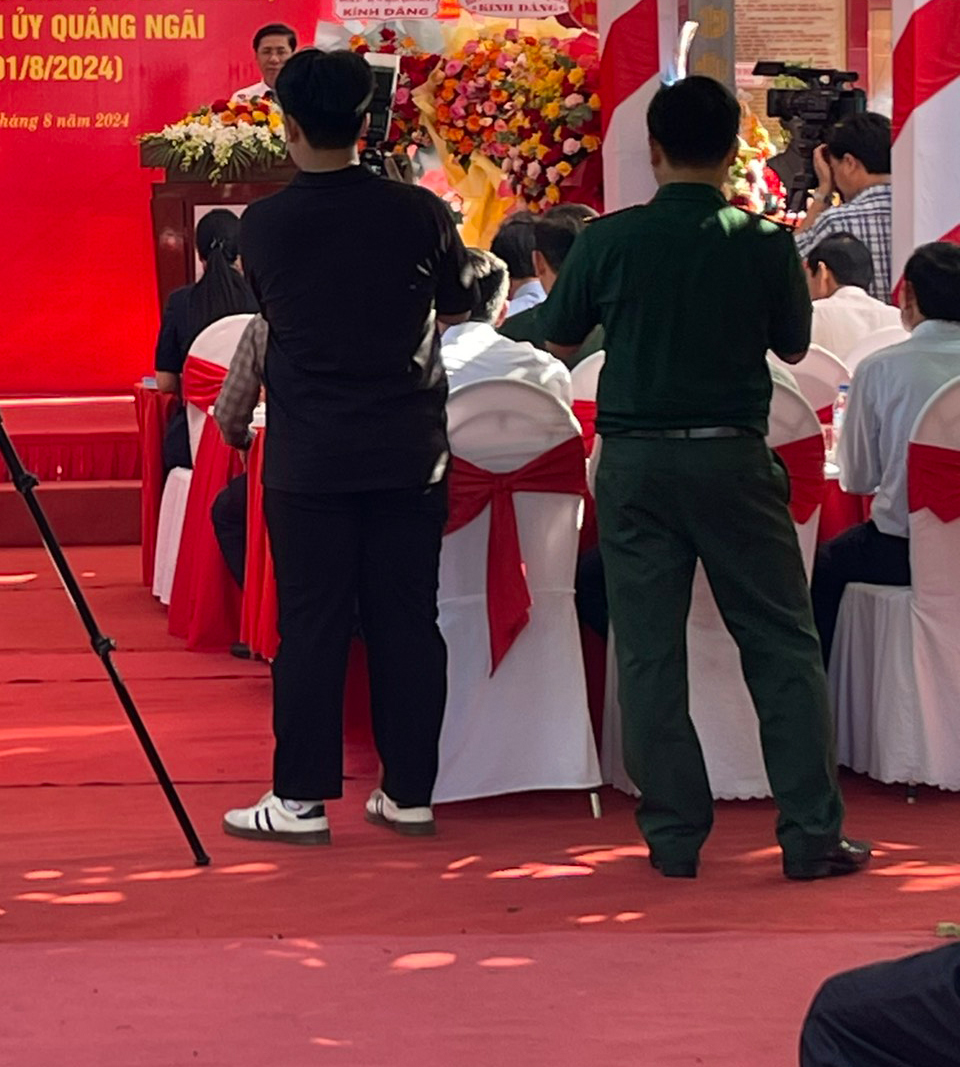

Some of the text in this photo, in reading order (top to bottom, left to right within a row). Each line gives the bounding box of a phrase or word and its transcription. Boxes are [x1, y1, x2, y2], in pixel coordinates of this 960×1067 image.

[11, 6, 44, 40] ỦY
[51, 6, 137, 43] QUẢNG
[144, 8, 206, 40] NGÃI
[43, 114, 52, 128] 8
[56, 113, 91, 129] năm
[95, 112, 129, 128] 2024
